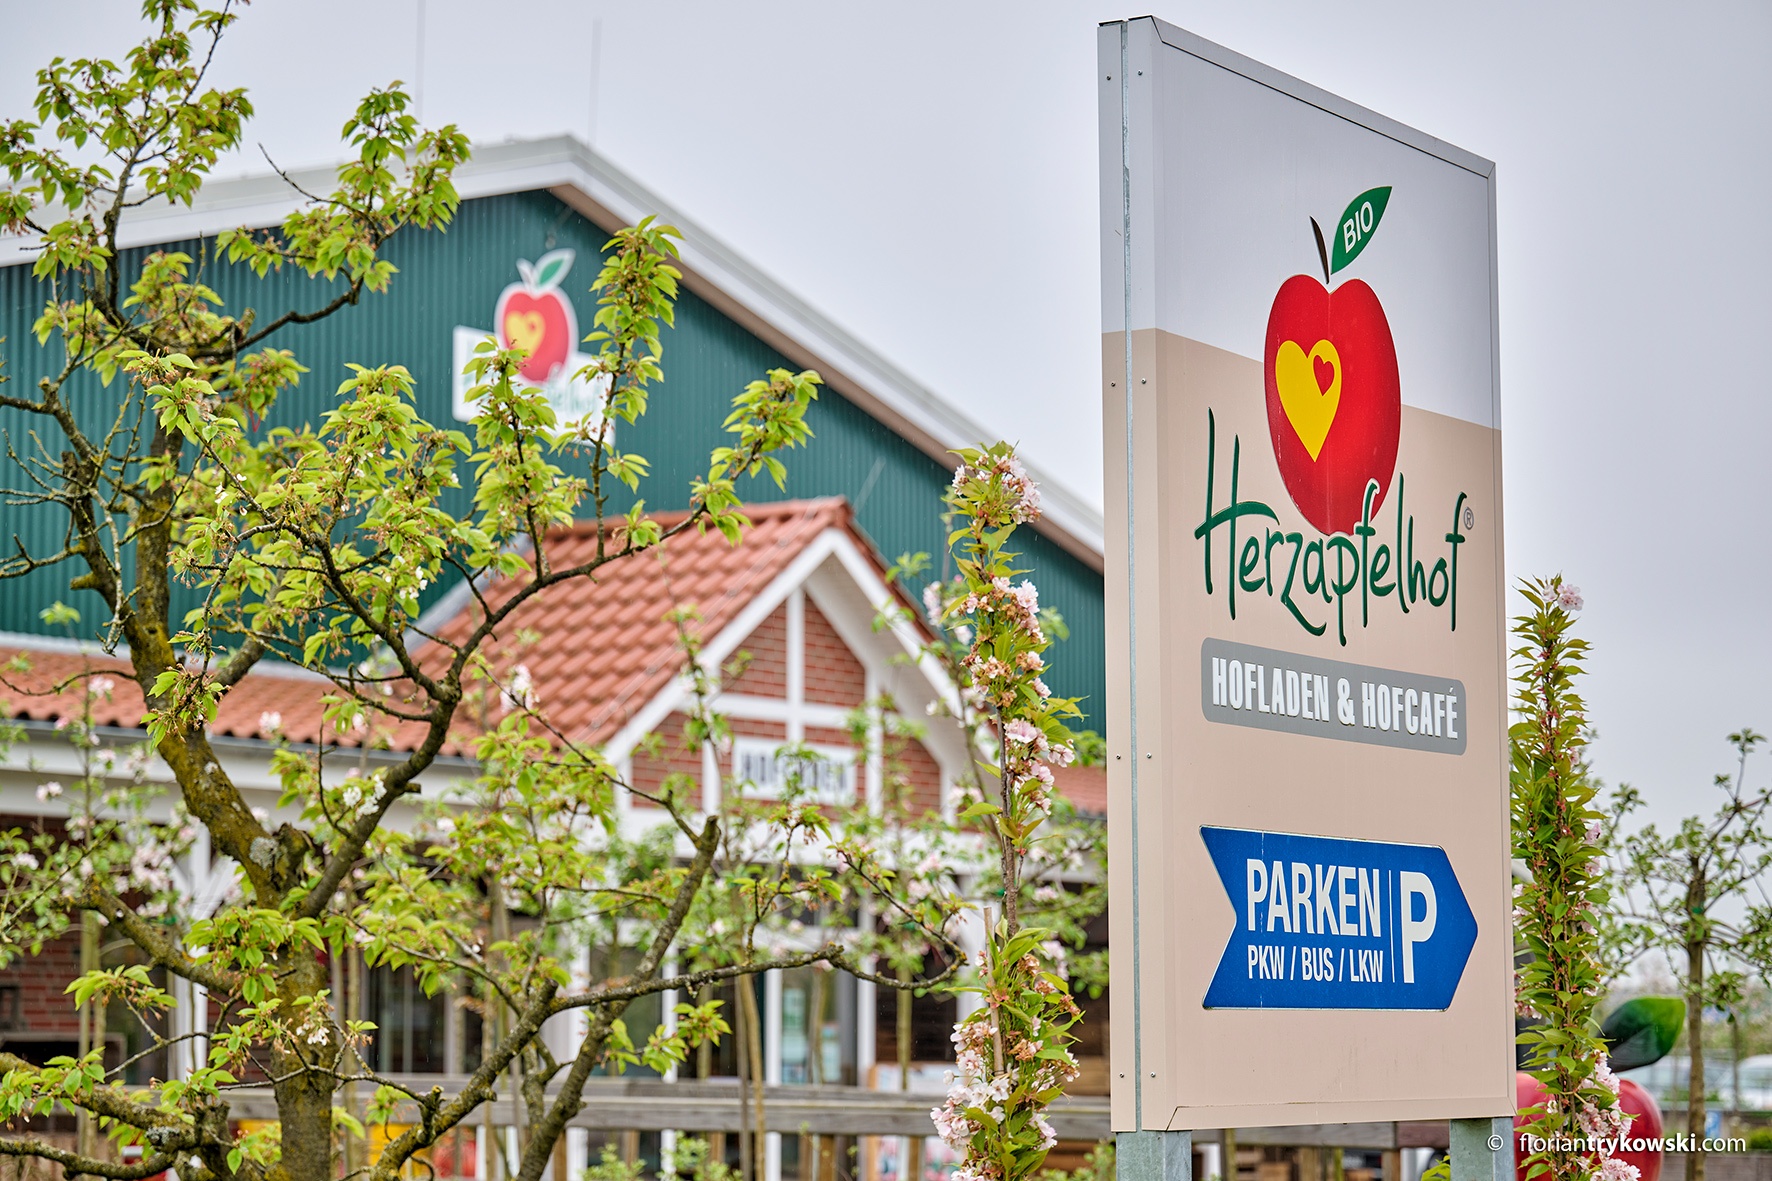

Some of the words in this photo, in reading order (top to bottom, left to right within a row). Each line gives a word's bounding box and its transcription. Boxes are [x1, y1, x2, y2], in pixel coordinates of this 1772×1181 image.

[1343, 201, 1374, 254] BIO
[1211, 656, 1330, 723] HOFLADEN
[1337, 677, 1356, 727] &
[1361, 680, 1459, 740] HOFCAFÉ
[1246, 858, 1382, 938] PARKEN
[1399, 870, 1438, 984] P
[1247, 944, 1285, 980] PKW
[1301, 946, 1334, 982] BUS
[1349, 948, 1384, 983] LKW
